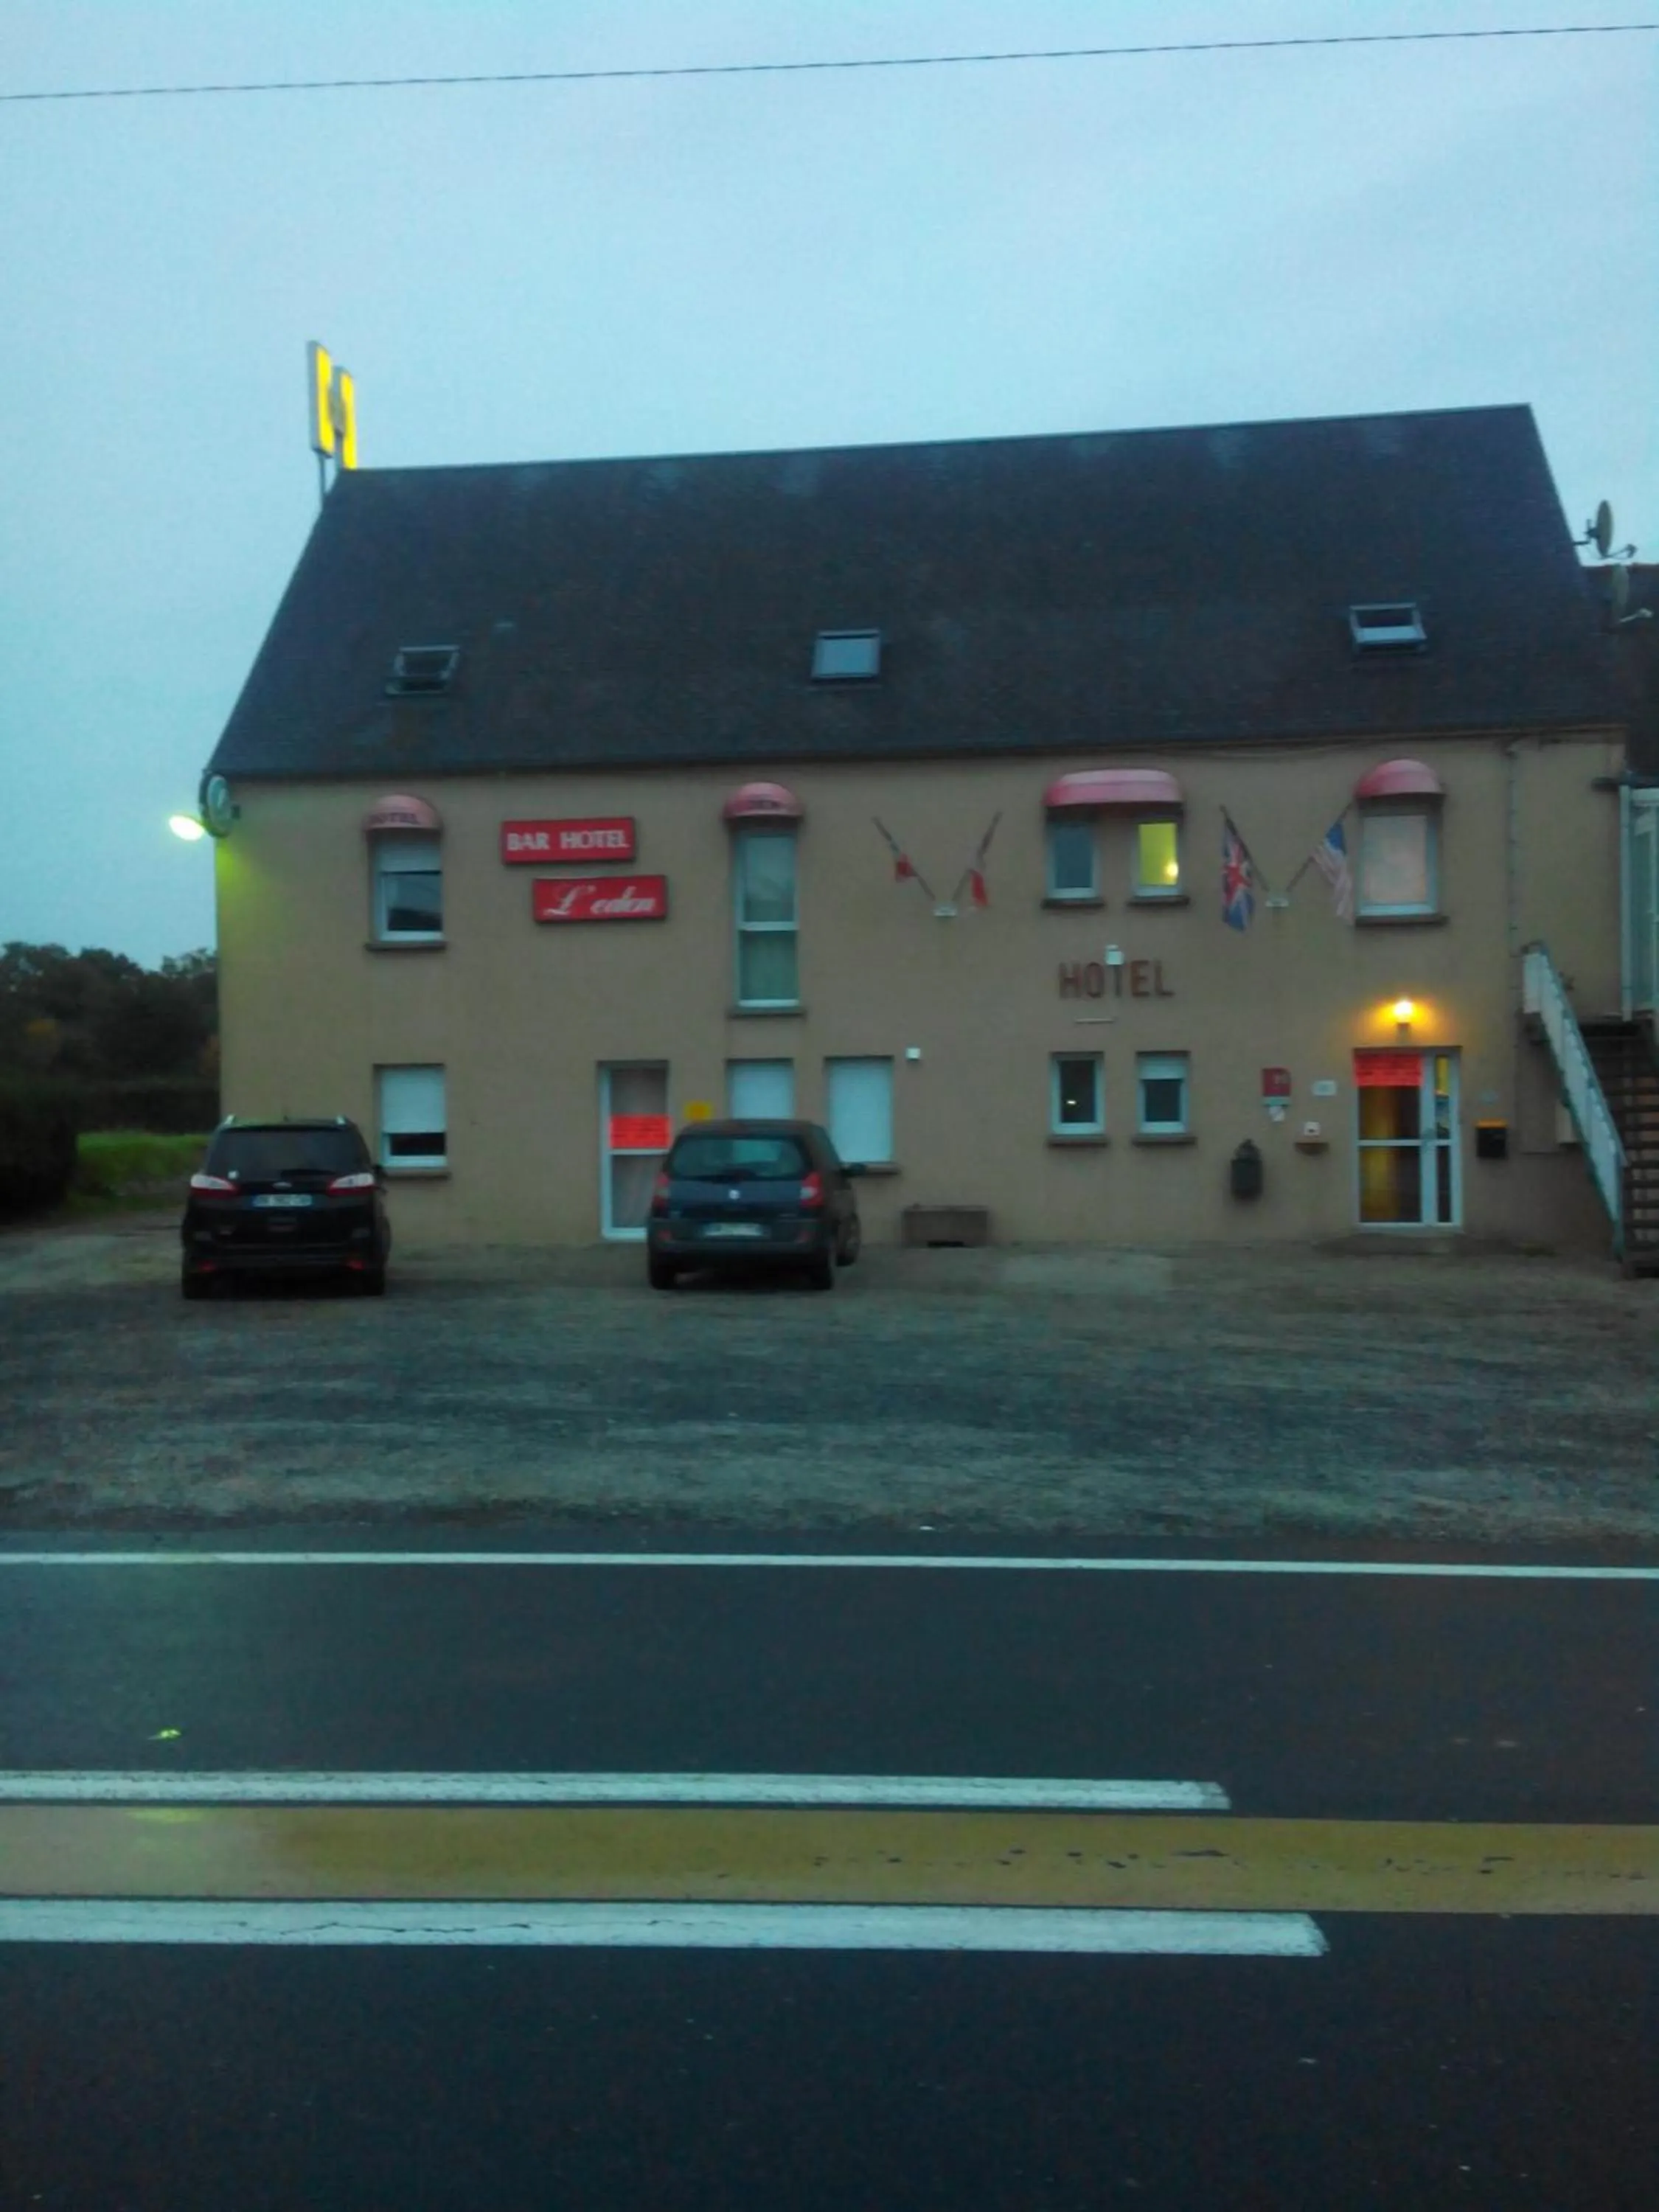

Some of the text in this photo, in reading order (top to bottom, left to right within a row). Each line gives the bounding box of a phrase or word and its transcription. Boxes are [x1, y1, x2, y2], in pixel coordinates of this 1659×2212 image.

[507, 830, 631, 851] BAR HOTEL
[1058, 959, 1176, 1000] HOTEL
